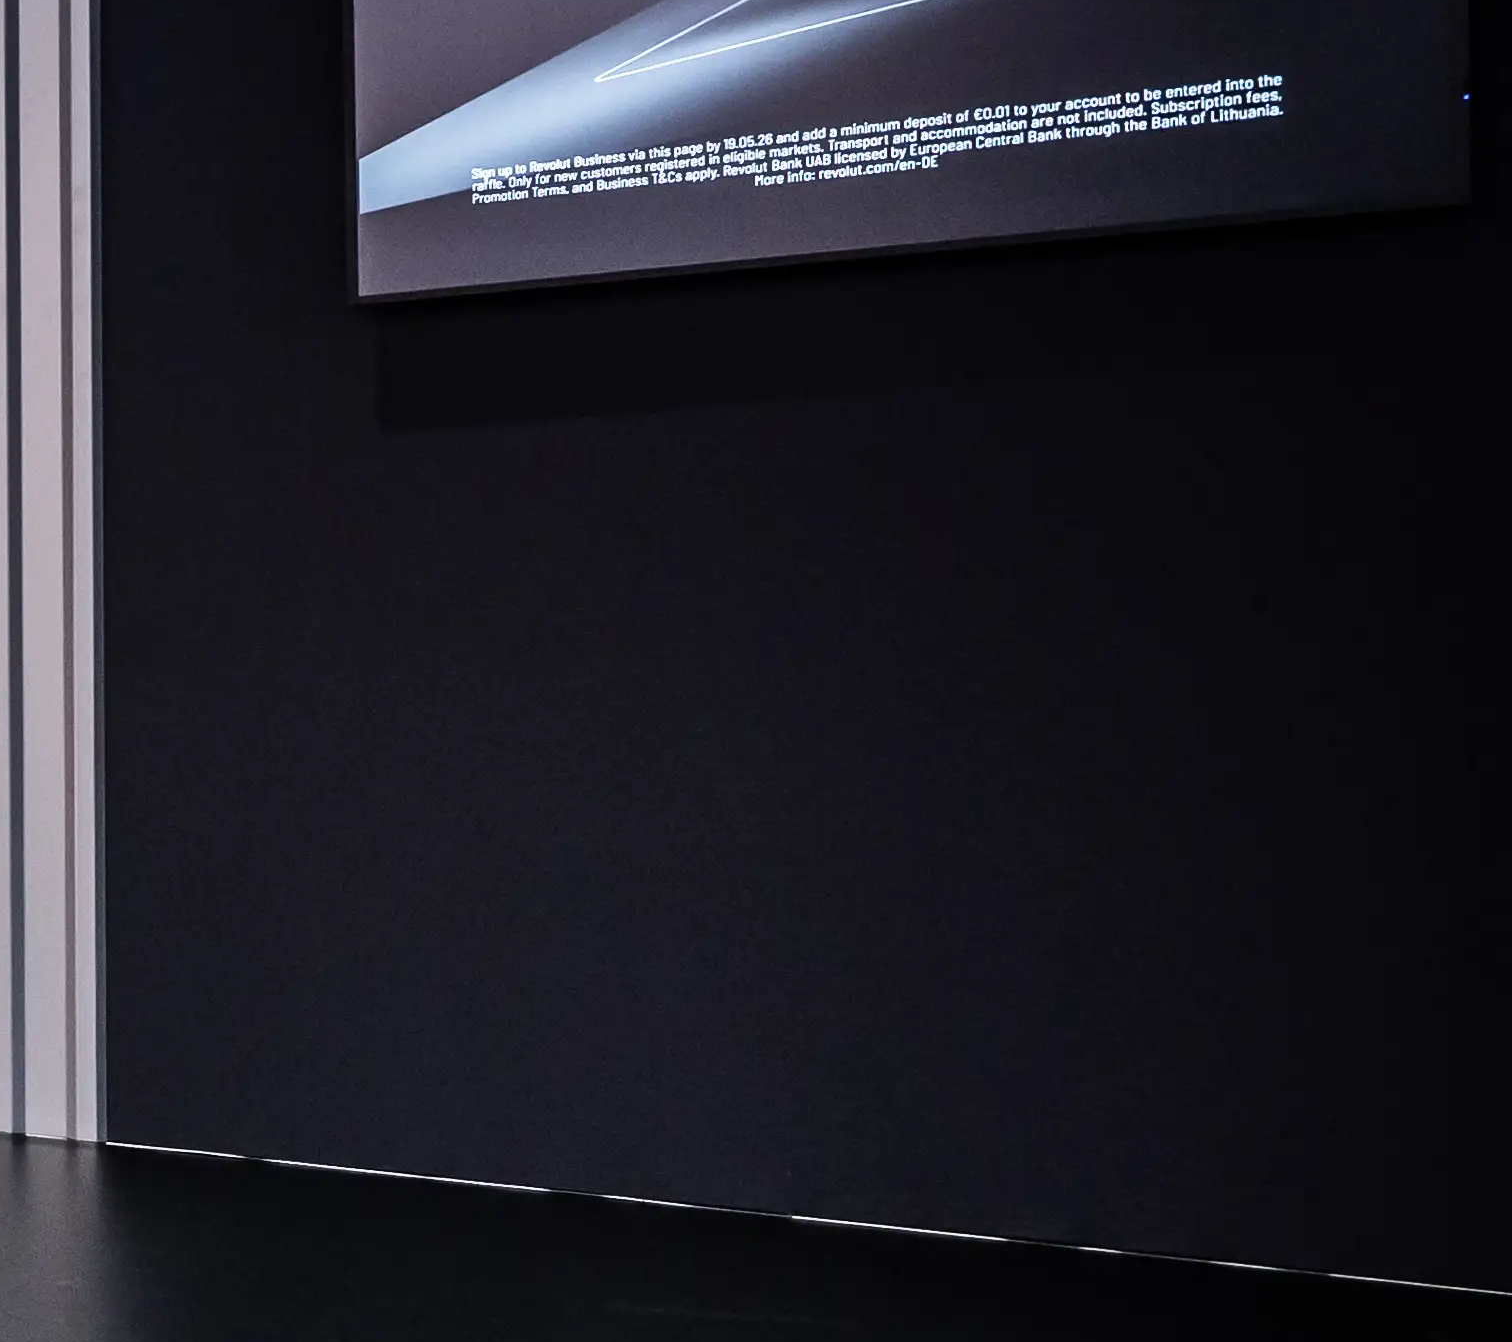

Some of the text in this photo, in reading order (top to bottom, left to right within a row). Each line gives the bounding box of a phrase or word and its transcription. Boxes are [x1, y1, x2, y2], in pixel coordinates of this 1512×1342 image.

[471, 74, 1283, 180] Sign up to Revolut Business via this page by 19.05.26 and add a minimum deposit of €0.01 to your account to be entered into the
[472, 190, 529, 204] Promotion
[572, 181, 593, 194] and
[597, 175, 649, 191] Business
[652, 171, 683, 184] T&Cs
[685, 167, 720, 183] apply.
[723, 161, 768, 177] Revolut
[771, 158, 803, 172] Bank
[806, 153, 831, 168] UAB
[834, 148, 888, 164] licensed
[891, 146, 907, 159] by
[909, 140, 973, 156] European
[975, 132, 1024, 149] Central
[1027, 127, 1062, 143] Bank
[1065, 121, 1121, 139] through
[1124, 119, 1148, 132] the
[1151, 113, 1188, 130] Bank
[1191, 110, 1206, 124] of
[1210, 104, 1283, 123] Lithuania.
[508, 175, 532, 189] Only
[535, 173, 551, 185] for
[554, 171, 578, 182] new
[580, 163, 642, 180] customers
[645, 155, 705, 173] registered
[708, 154, 720, 165] in
[723, 148, 766, 164] eligible
[769, 143, 824, 158] markets.
[828, 135, 889, 151] Transport
[893, 130, 917, 144] and
[920, 119, 1027, 138] accommodation
[1030, 116, 1054, 129] are
[1057, 112, 1080, 125] not
[1084, 104, 1147, 123] included.
[1151, 94, 1242, 115] Subscription
[1246, 90, 1283, 104] fees,
[754, 155, 939, 187] More info: revolut.com/en-DE
